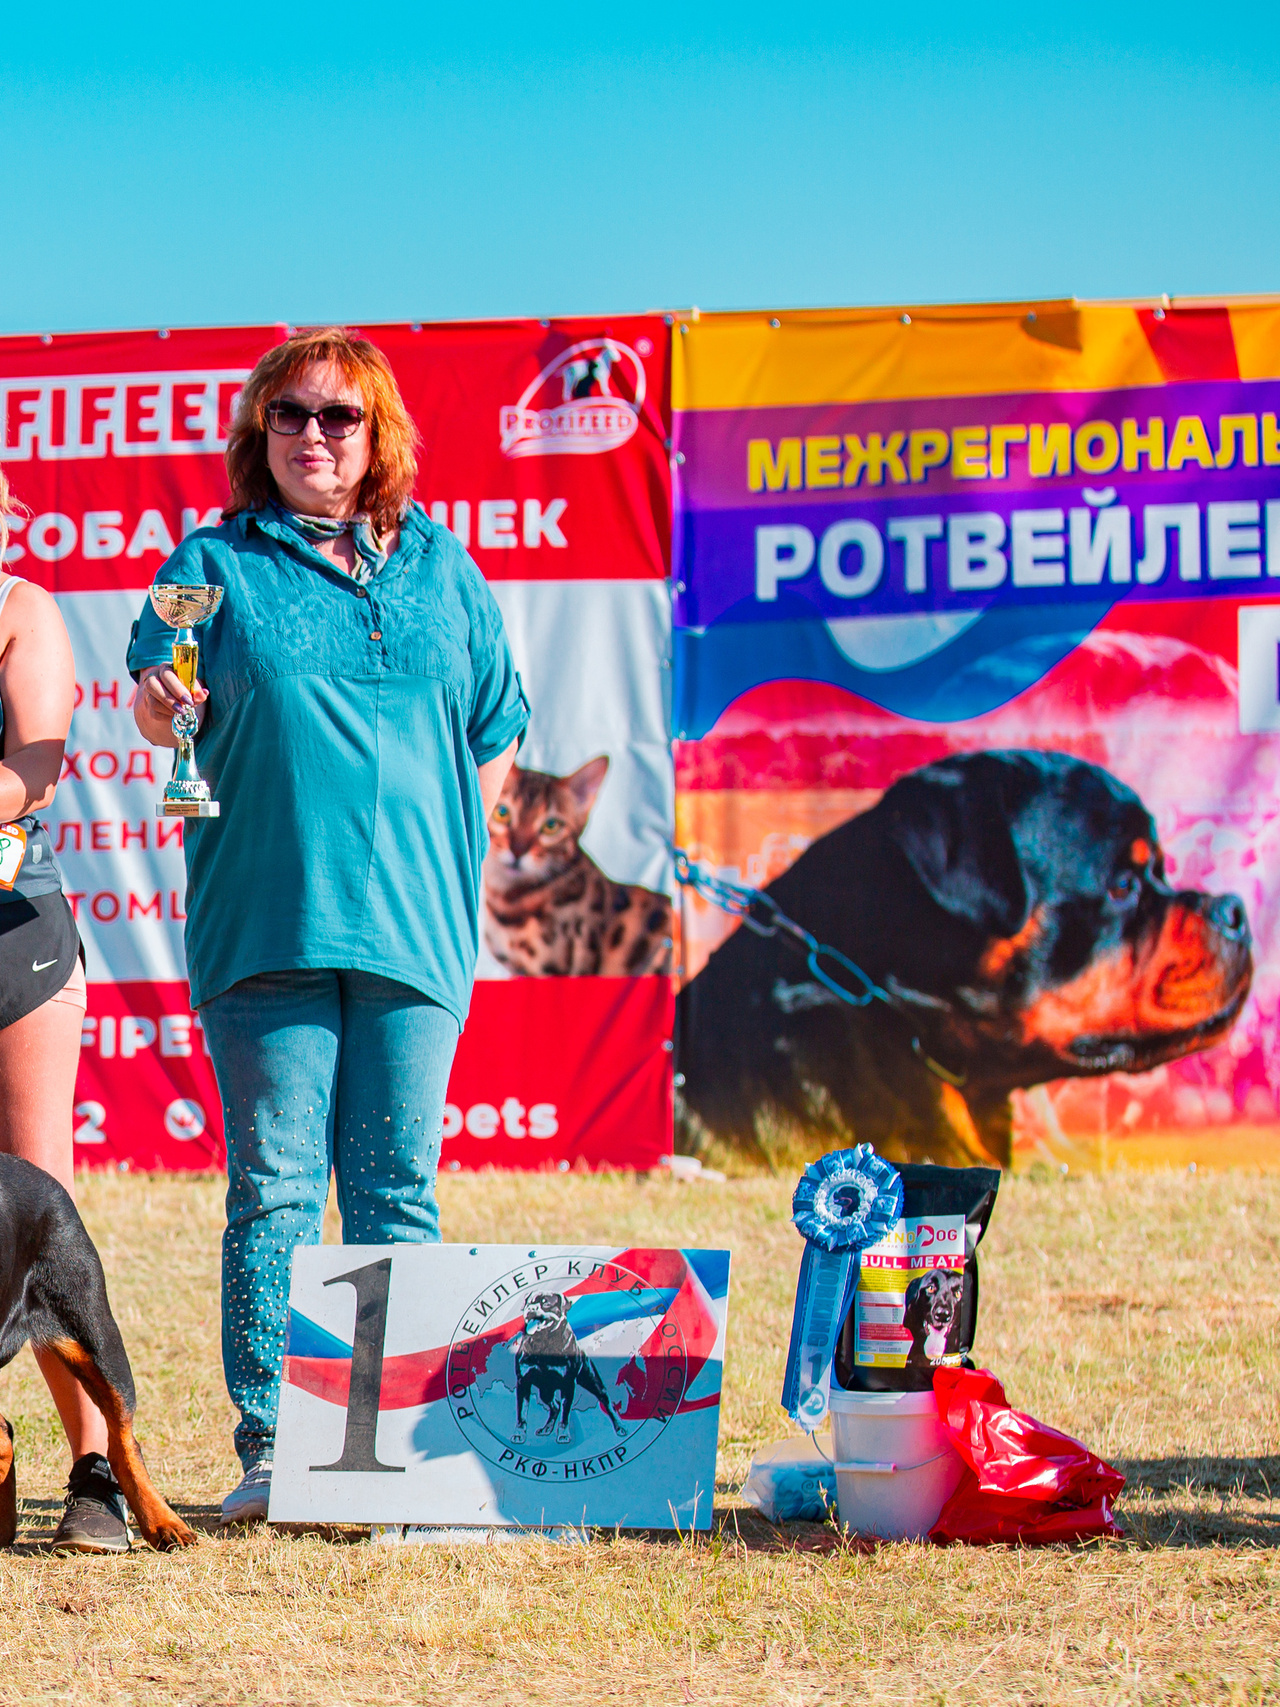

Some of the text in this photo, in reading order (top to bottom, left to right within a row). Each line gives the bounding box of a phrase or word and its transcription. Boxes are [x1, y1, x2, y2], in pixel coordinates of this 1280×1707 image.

[567, 1261, 646, 1297] КЛУБ
[860, 1255, 958, 1269] BULL MEAT
[309, 1258, 406, 1472] 1
[498, 1446, 628, 1480] РКФ-НКПР
